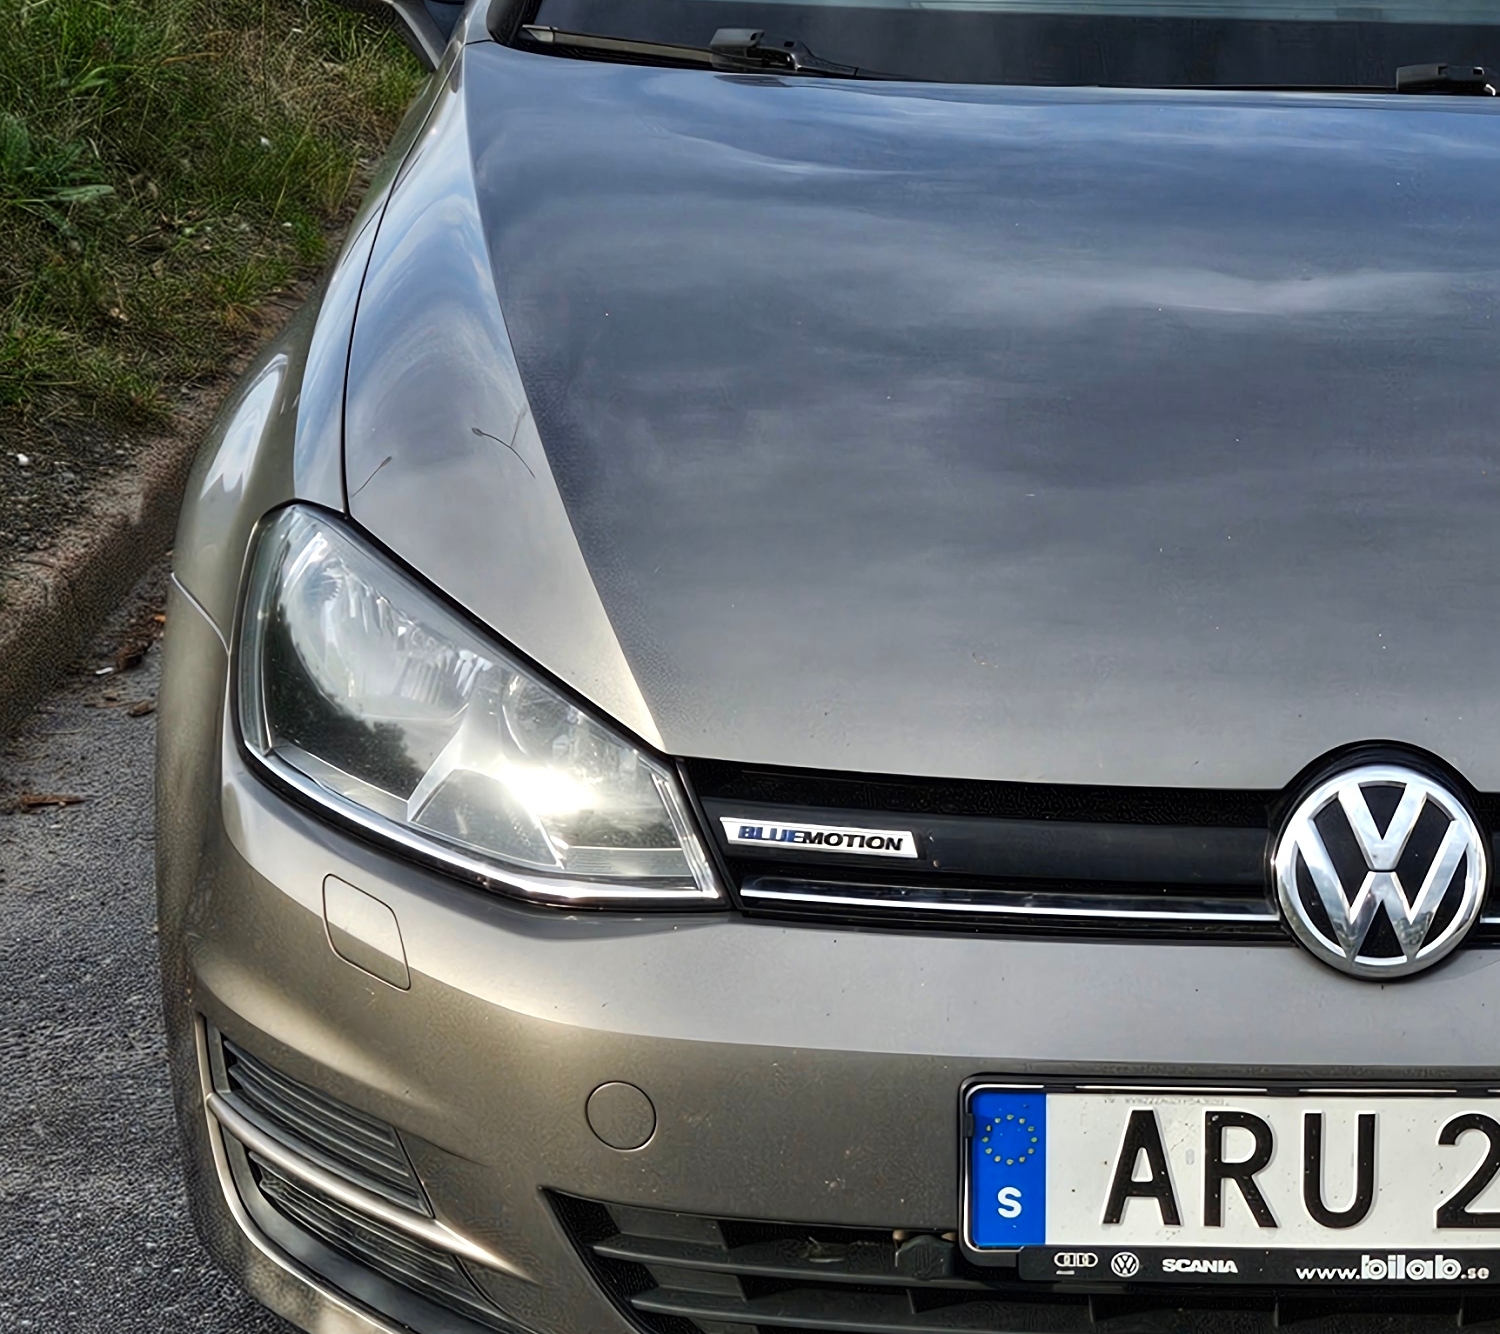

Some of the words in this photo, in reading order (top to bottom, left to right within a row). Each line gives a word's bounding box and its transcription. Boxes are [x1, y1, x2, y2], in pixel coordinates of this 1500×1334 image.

[738, 826, 904, 851] BLUEMOTION
[1277, 767, 1486, 976] VW
[1100, 1109, 1377, 1229] ARU
[997, 1186, 1023, 1218] S
[1161, 1258, 1239, 1274] SCANIA
[1296, 1254, 1490, 1281] www.bilab.se
